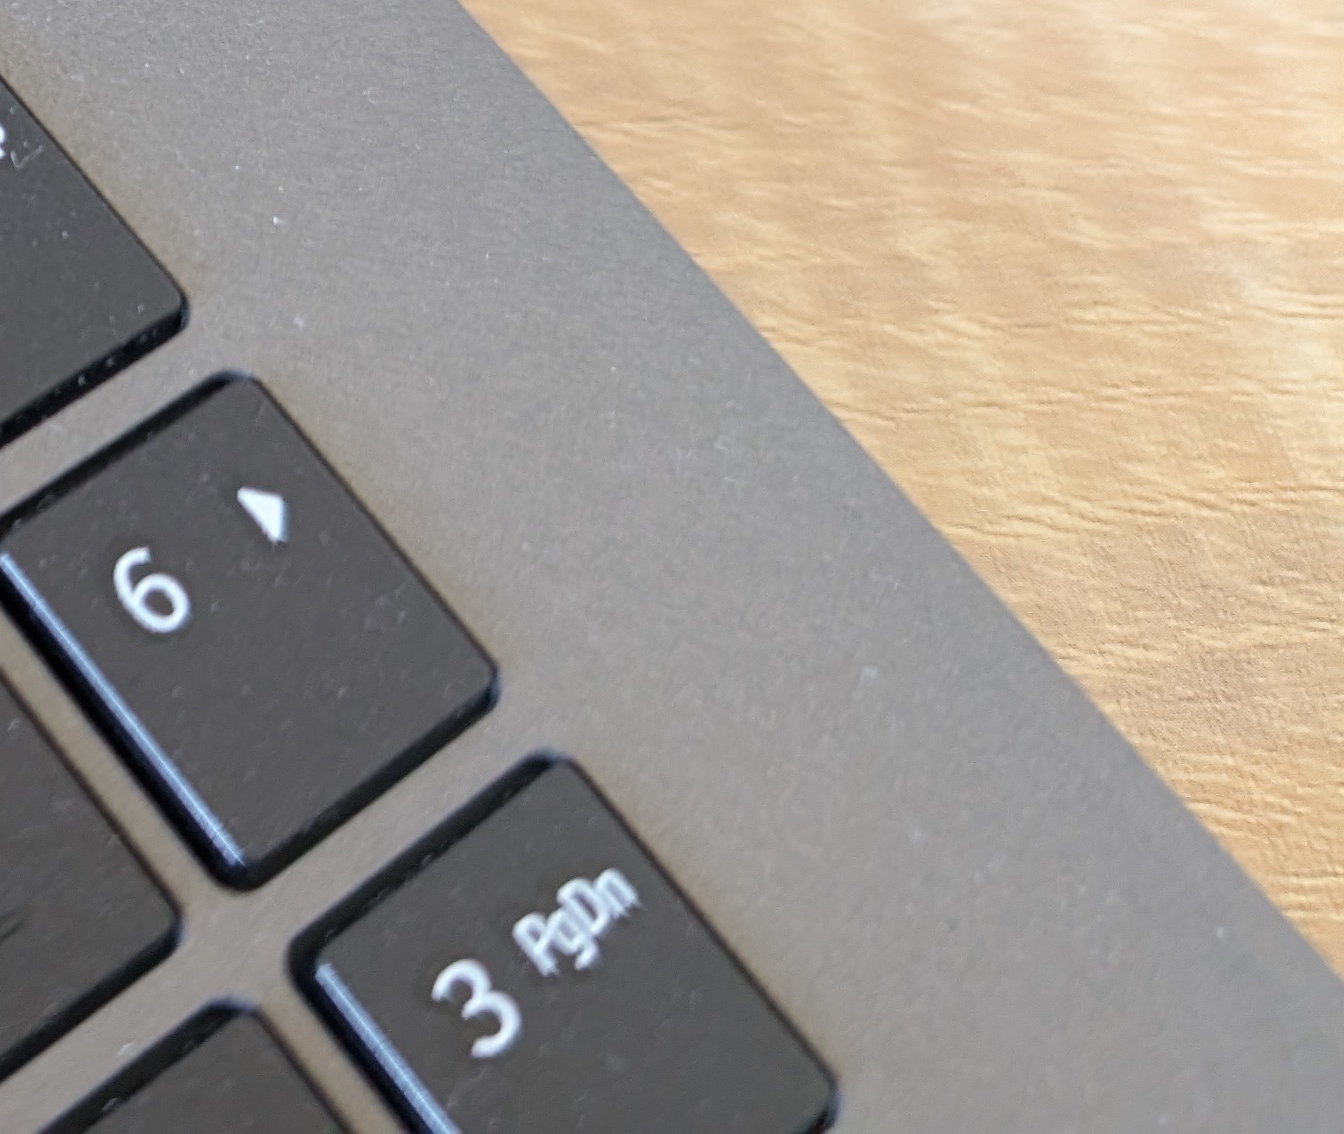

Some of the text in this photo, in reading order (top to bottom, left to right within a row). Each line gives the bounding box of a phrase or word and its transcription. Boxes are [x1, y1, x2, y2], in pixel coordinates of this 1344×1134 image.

[111, 545, 192, 634] 6
[430, 866, 641, 1060] 3 PgDn
